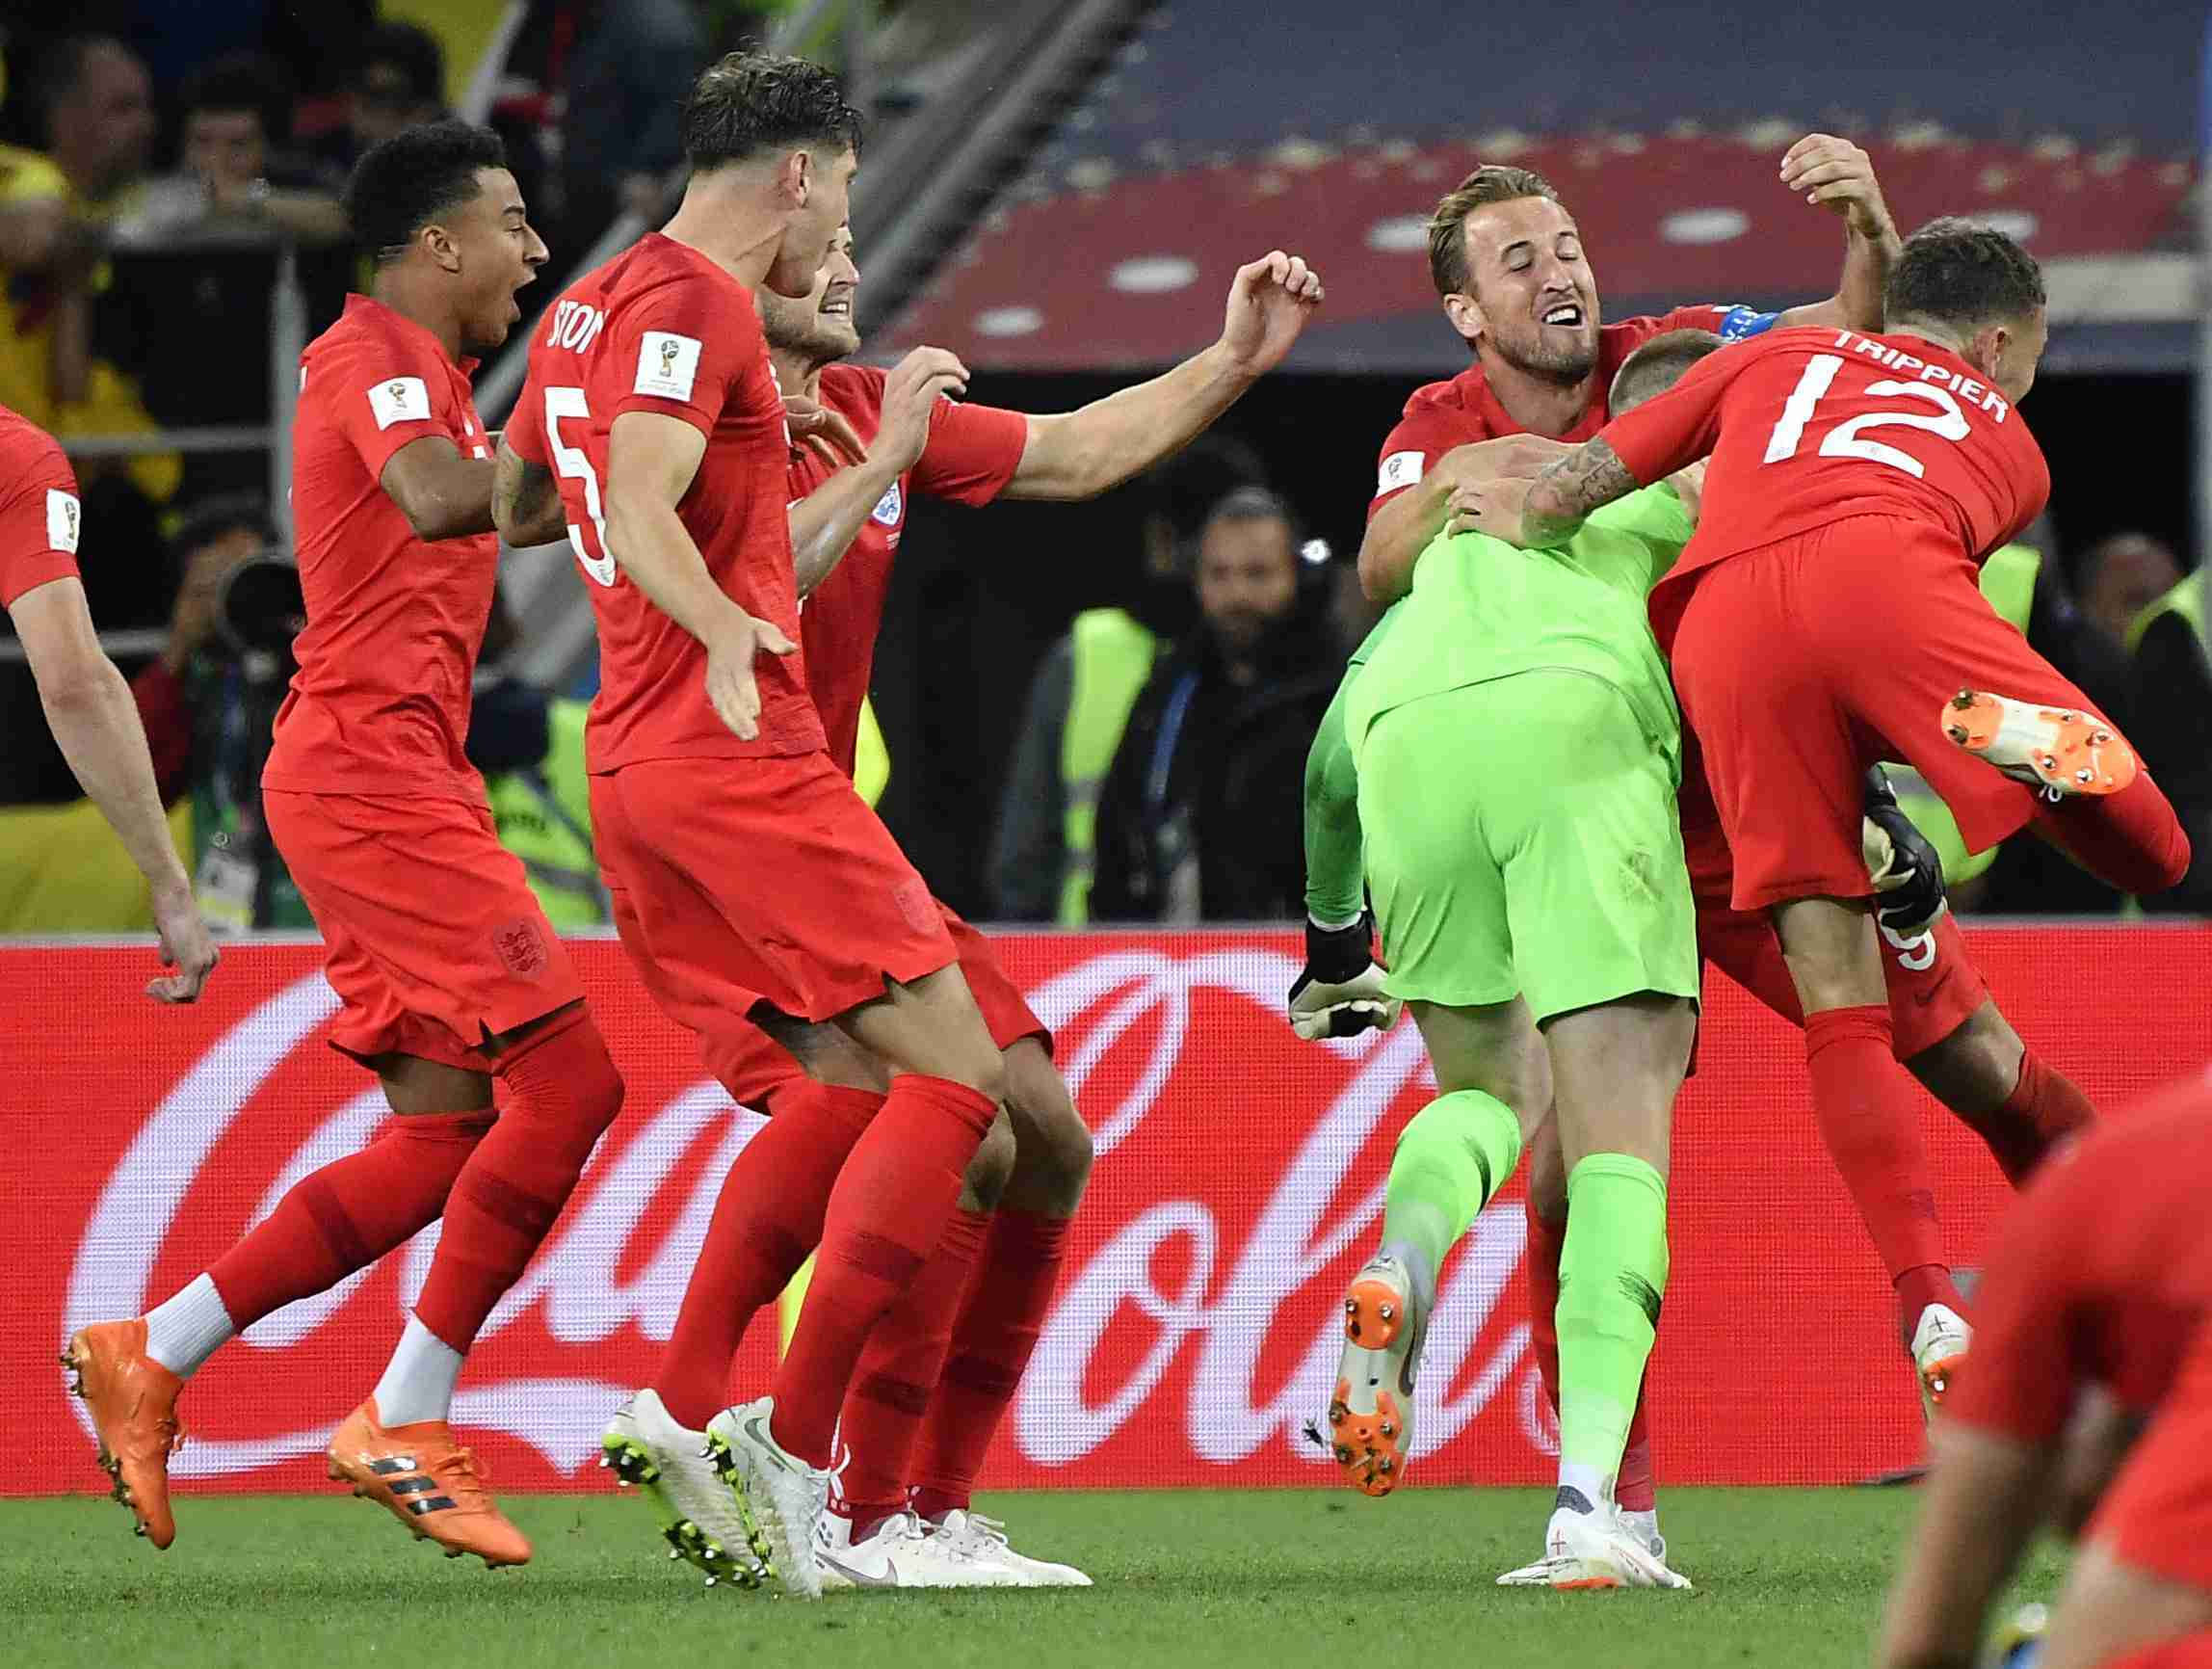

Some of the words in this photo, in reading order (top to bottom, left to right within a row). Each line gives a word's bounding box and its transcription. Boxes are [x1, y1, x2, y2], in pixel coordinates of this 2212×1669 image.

[1762, 353, 1972, 479] 12
[1834, 331, 2010, 424] TRIPPIER
[543, 385, 617, 587] 5
